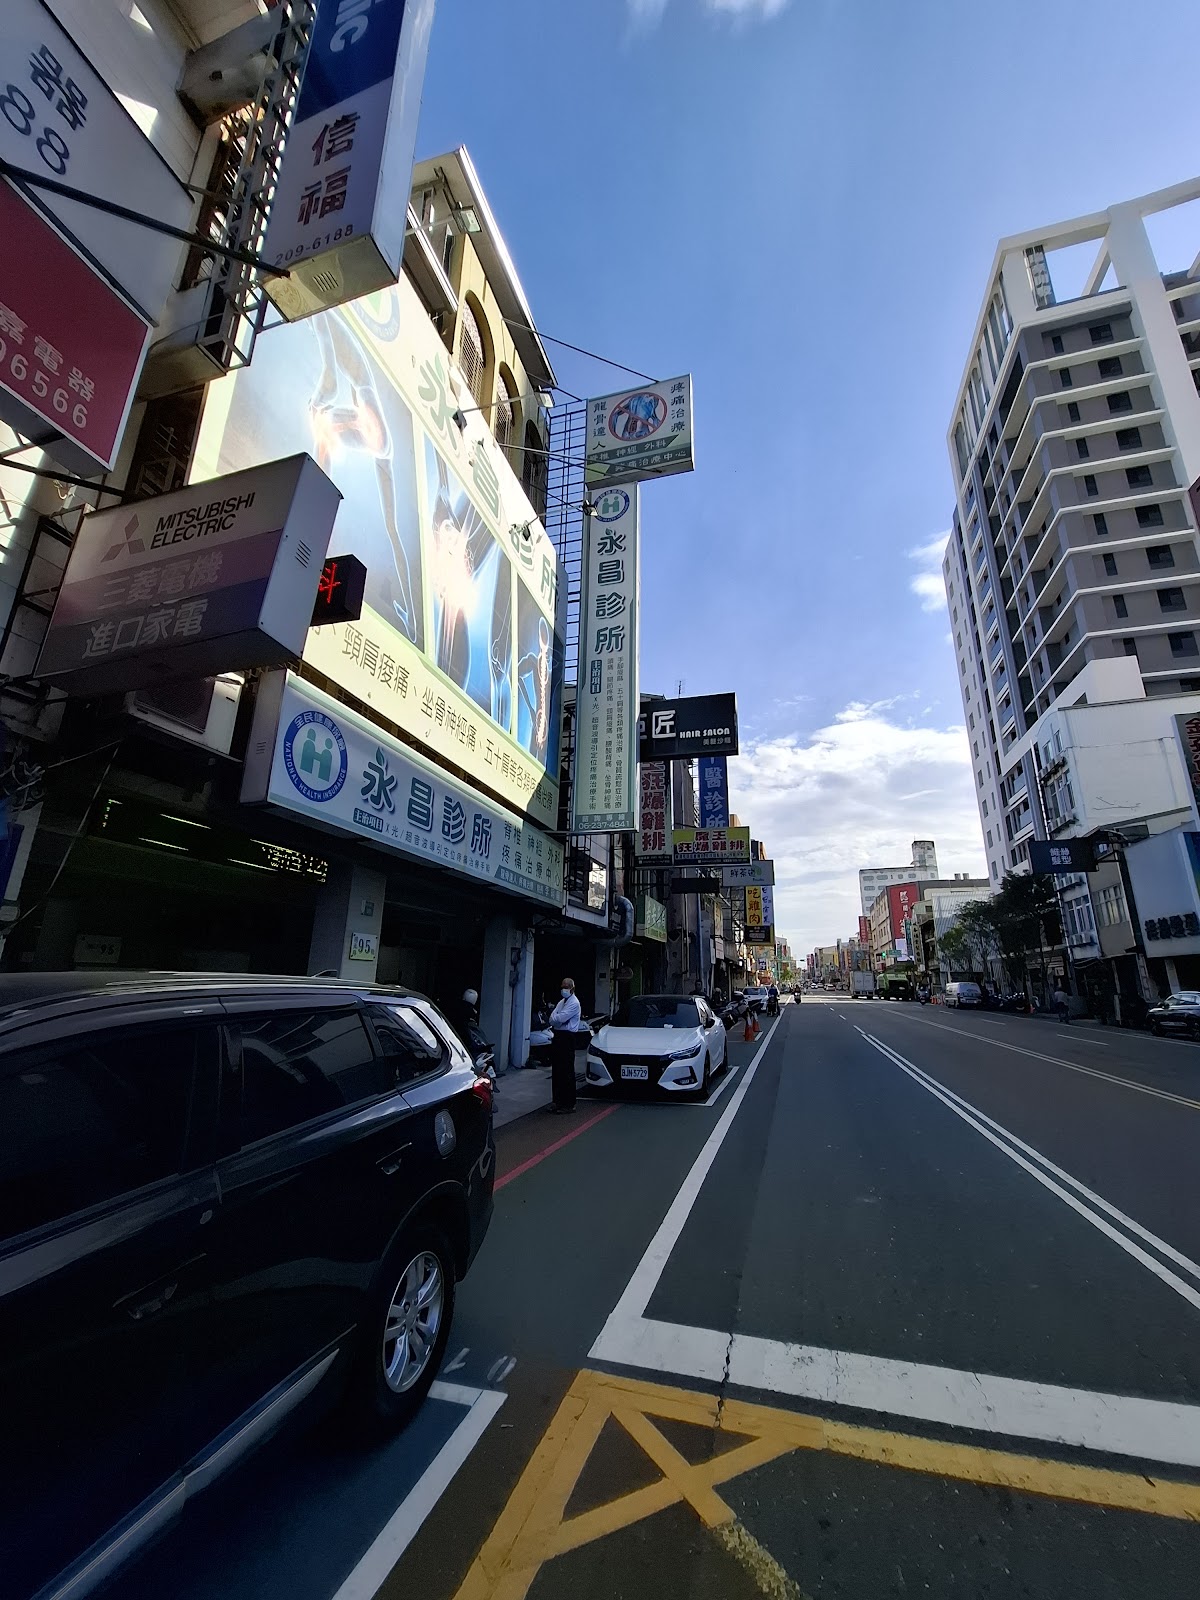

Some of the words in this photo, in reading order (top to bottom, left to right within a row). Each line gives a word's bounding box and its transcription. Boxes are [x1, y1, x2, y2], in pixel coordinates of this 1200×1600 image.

[28, 43, 89, 131] 器
[297, 111, 361, 226] 信福
[275, 223, 355, 266] 209-6188
[592, 401, 608, 451] 龍骨達人
[670, 381, 686, 433] 疼痛治療
[150, 514, 237, 550] ELECTRIC
[155, 492, 256, 533] MITSUBISHI
[100, 550, 224, 610] 三菱電機
[595, 528, 626, 654] 永昌診所
[82, 598, 209, 660] 進口家電
[591, 660, 601, 693] 主治項目
[293, 711, 346, 752] 全民健康保險
[680, 730, 701, 739] HAIR
[702, 727, 730, 737] SALON
[284, 741, 299, 785] NATIONAL
[298, 782, 322, 800] HEALTH
[322, 768, 347, 800] INSURANCE
[354, 809, 383, 831] 主治項目
[361, 746, 493, 860] 永昌診所
[358, 938, 371, 954] 95
